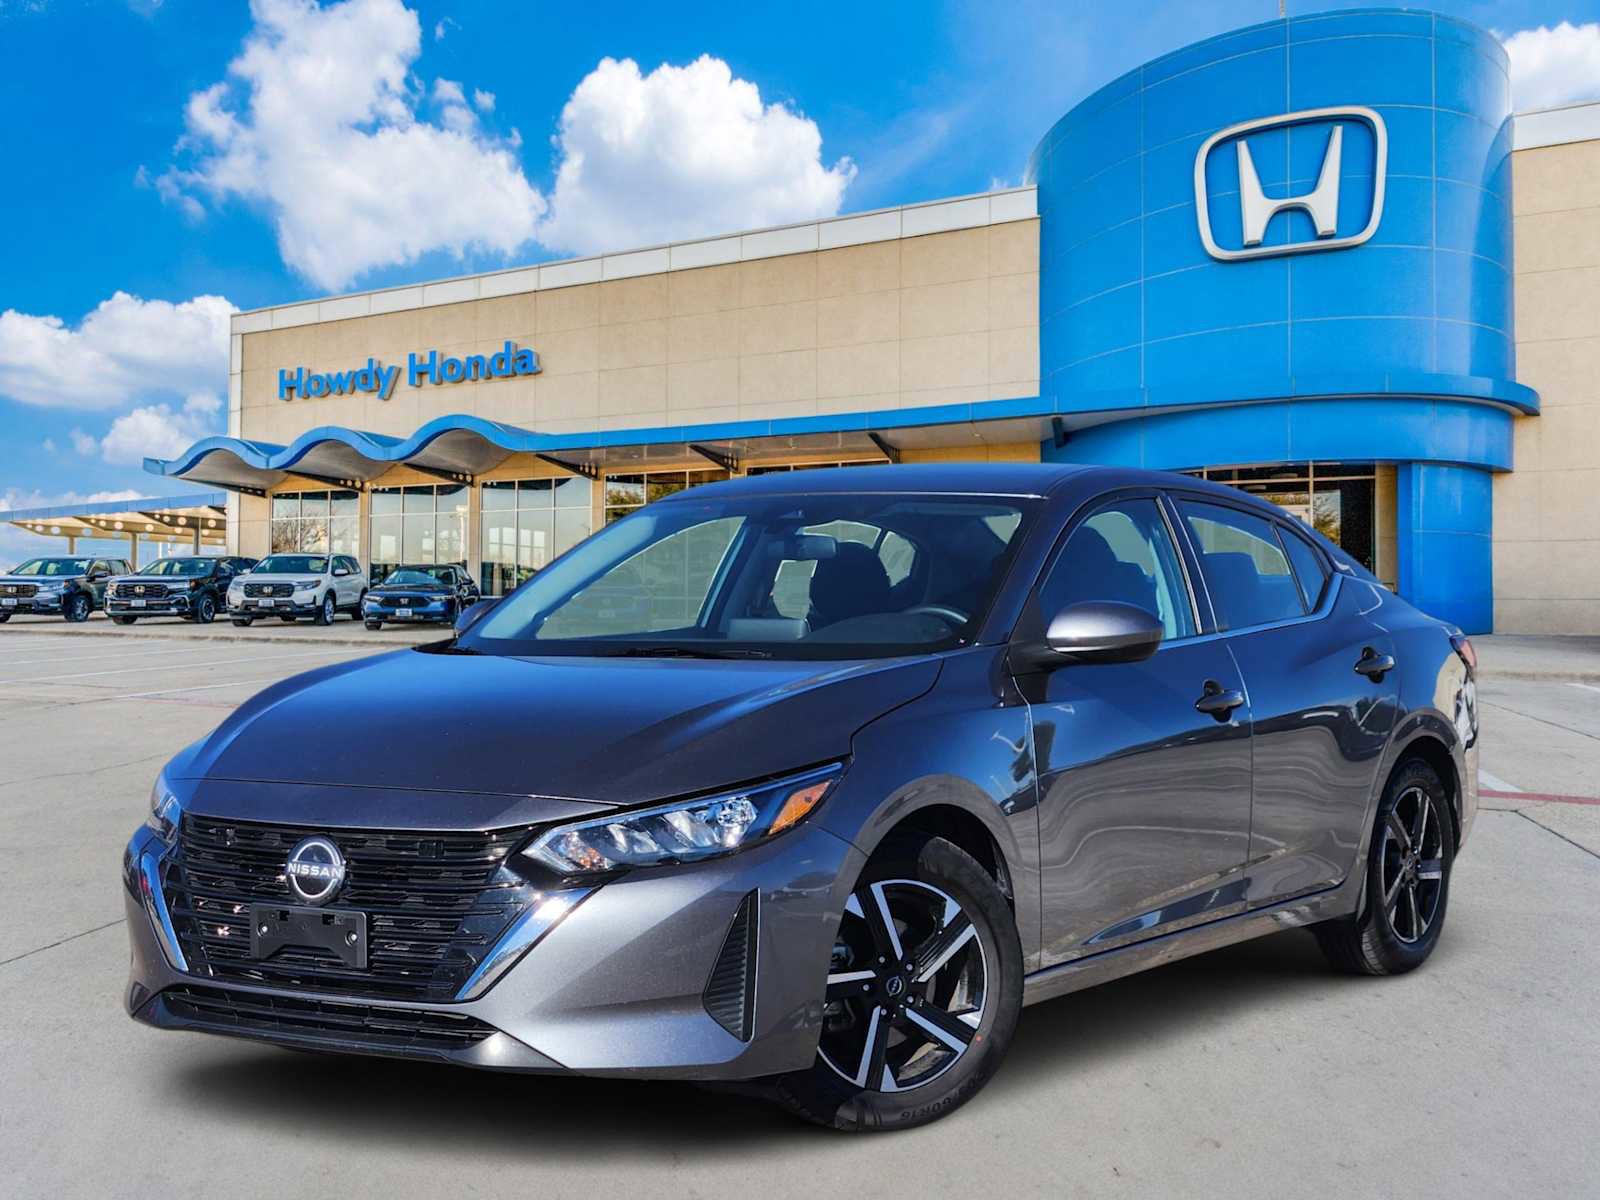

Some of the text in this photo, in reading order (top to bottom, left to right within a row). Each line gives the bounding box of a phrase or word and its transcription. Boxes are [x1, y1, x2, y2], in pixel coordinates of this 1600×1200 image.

[278, 340, 541, 400] Howdy Honda
[287, 862, 344, 878] NISSAN
